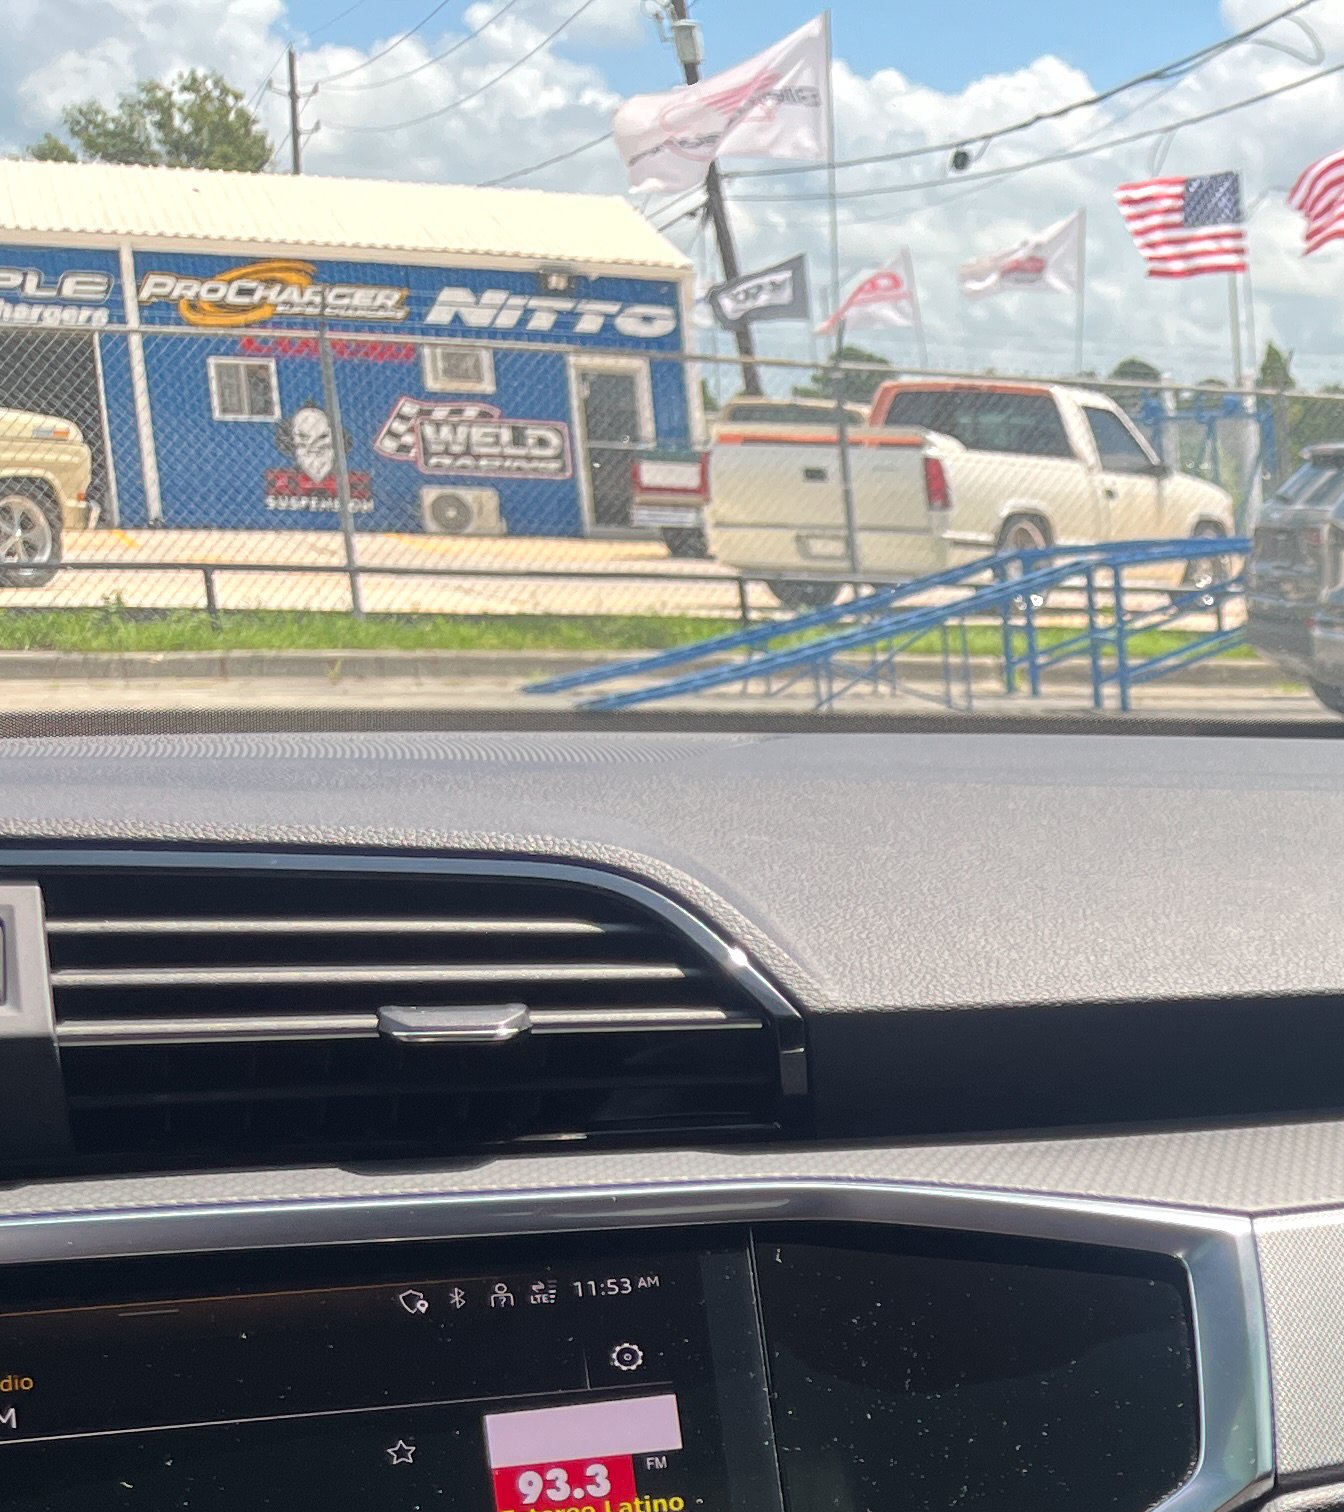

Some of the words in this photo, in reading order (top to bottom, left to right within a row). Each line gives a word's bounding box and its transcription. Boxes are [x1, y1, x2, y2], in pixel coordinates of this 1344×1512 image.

[423, 286, 677, 338] NITTO
[421, 423, 563, 458] WELD
[530, 1293, 550, 1304] LTE
[572, 1278, 632, 1298] 11:53
[637, 1276, 660, 1289] AM
[646, 1456, 668, 1471] FM
[517, 1463, 611, 1505] 93.3
